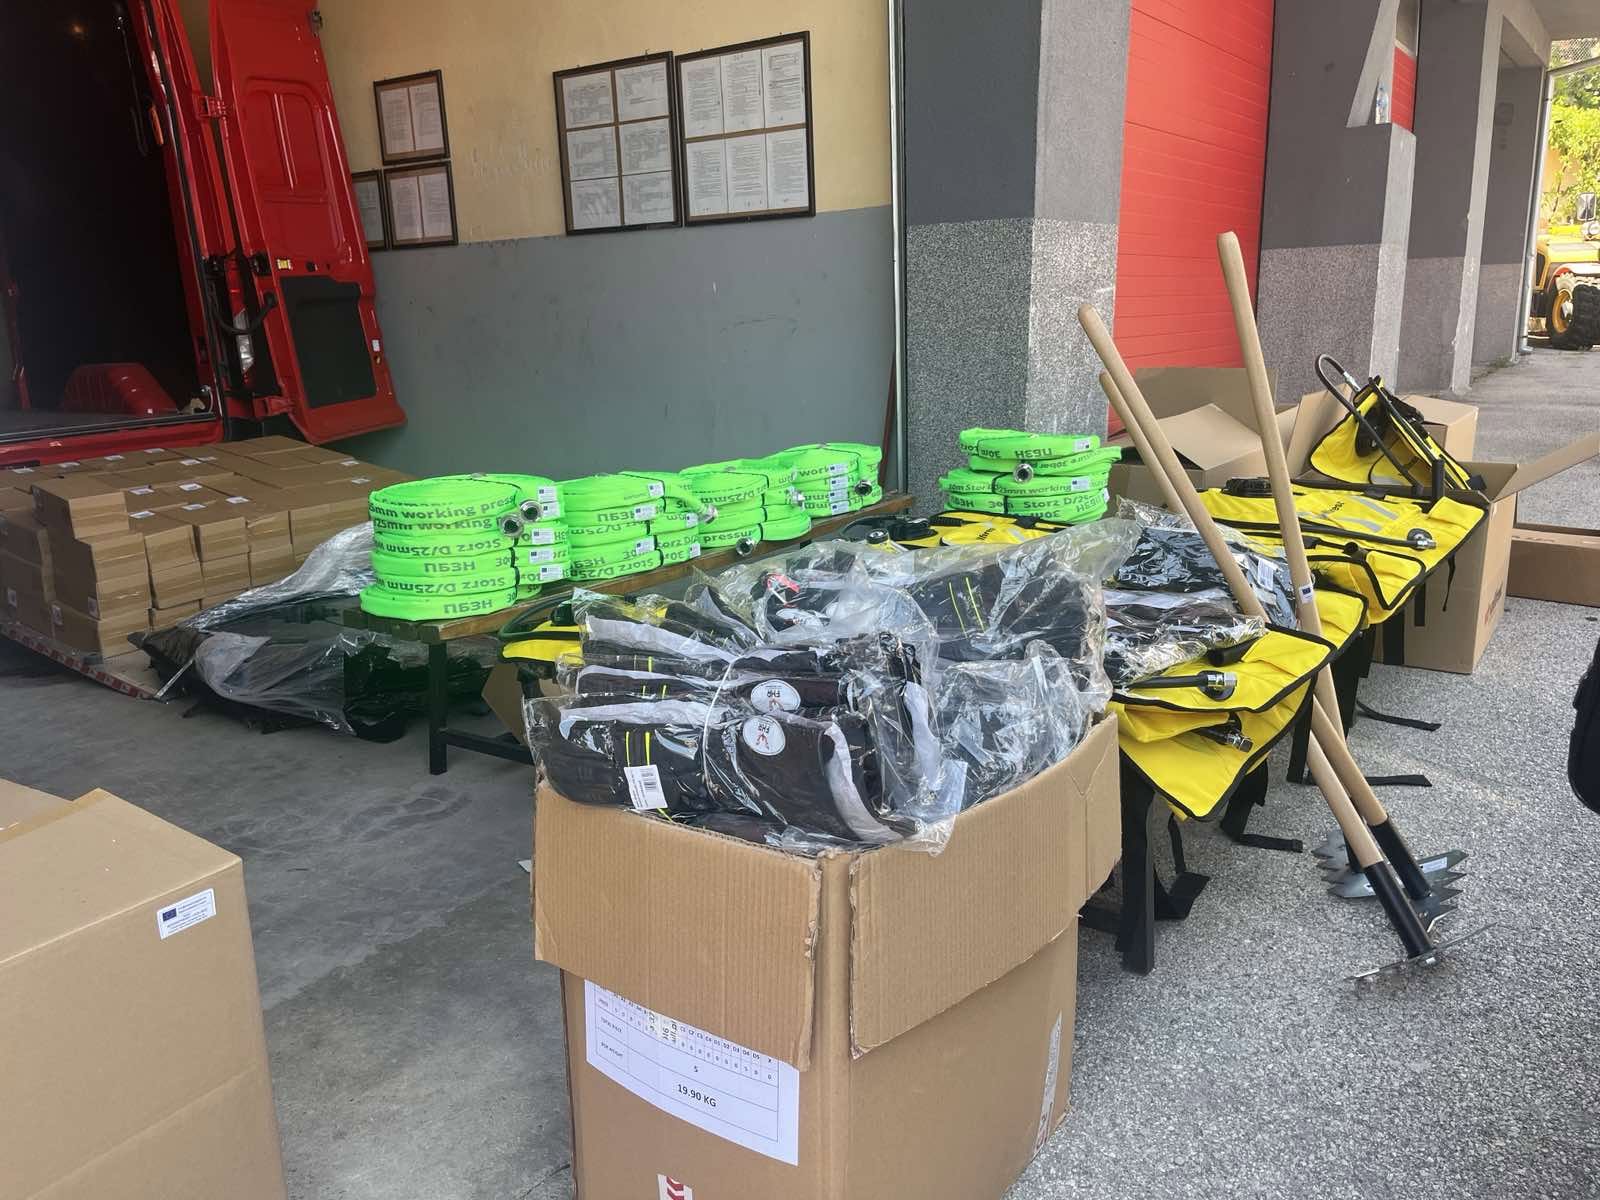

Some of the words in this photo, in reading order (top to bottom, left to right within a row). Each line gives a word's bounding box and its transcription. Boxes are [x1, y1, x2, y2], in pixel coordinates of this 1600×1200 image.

[401, 507, 476, 519] working
[480, 496, 515, 513] press
[1024, 501, 1060, 509] Storz
[418, 519, 492, 530] working
[703, 530, 753, 543] pressur
[386, 543, 451, 556] D/25mm
[457, 539, 501, 552] Storz
[424, 561, 476, 573] ПБЗН
[618, 559, 653, 571] Storz
[387, 581, 456, 593] D/25mm
[462, 577, 505, 589] Storz
[444, 600, 493, 613] ПБЗН
[677, 1084, 702, 1101] 19.90
[703, 1095, 717, 1107] KG
